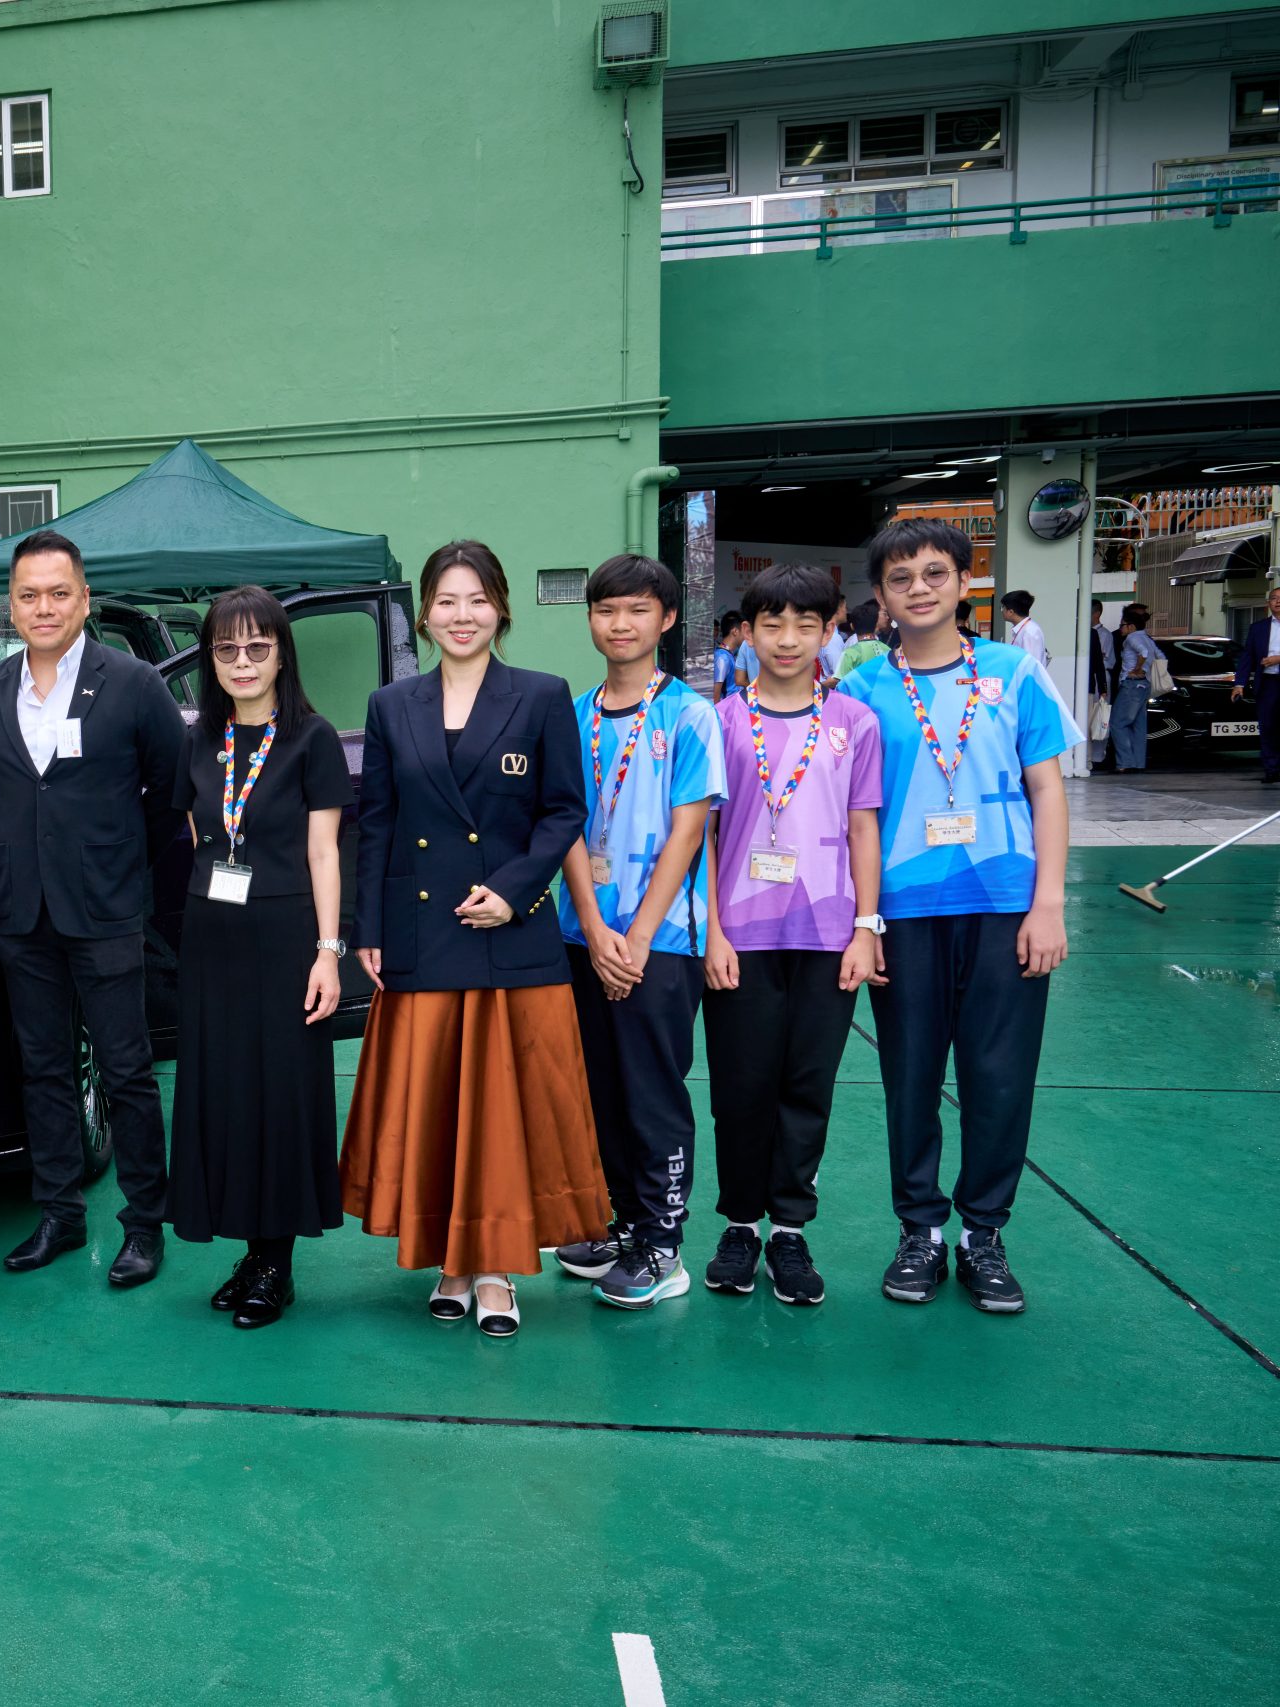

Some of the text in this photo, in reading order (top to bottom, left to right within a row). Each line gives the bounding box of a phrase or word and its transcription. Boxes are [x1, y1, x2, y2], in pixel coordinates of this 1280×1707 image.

[1176, 172, 1215, 180] Disciplinary
[1230, 166, 1270, 175] Counselling
[1214, 725, 1229, 733] TG
